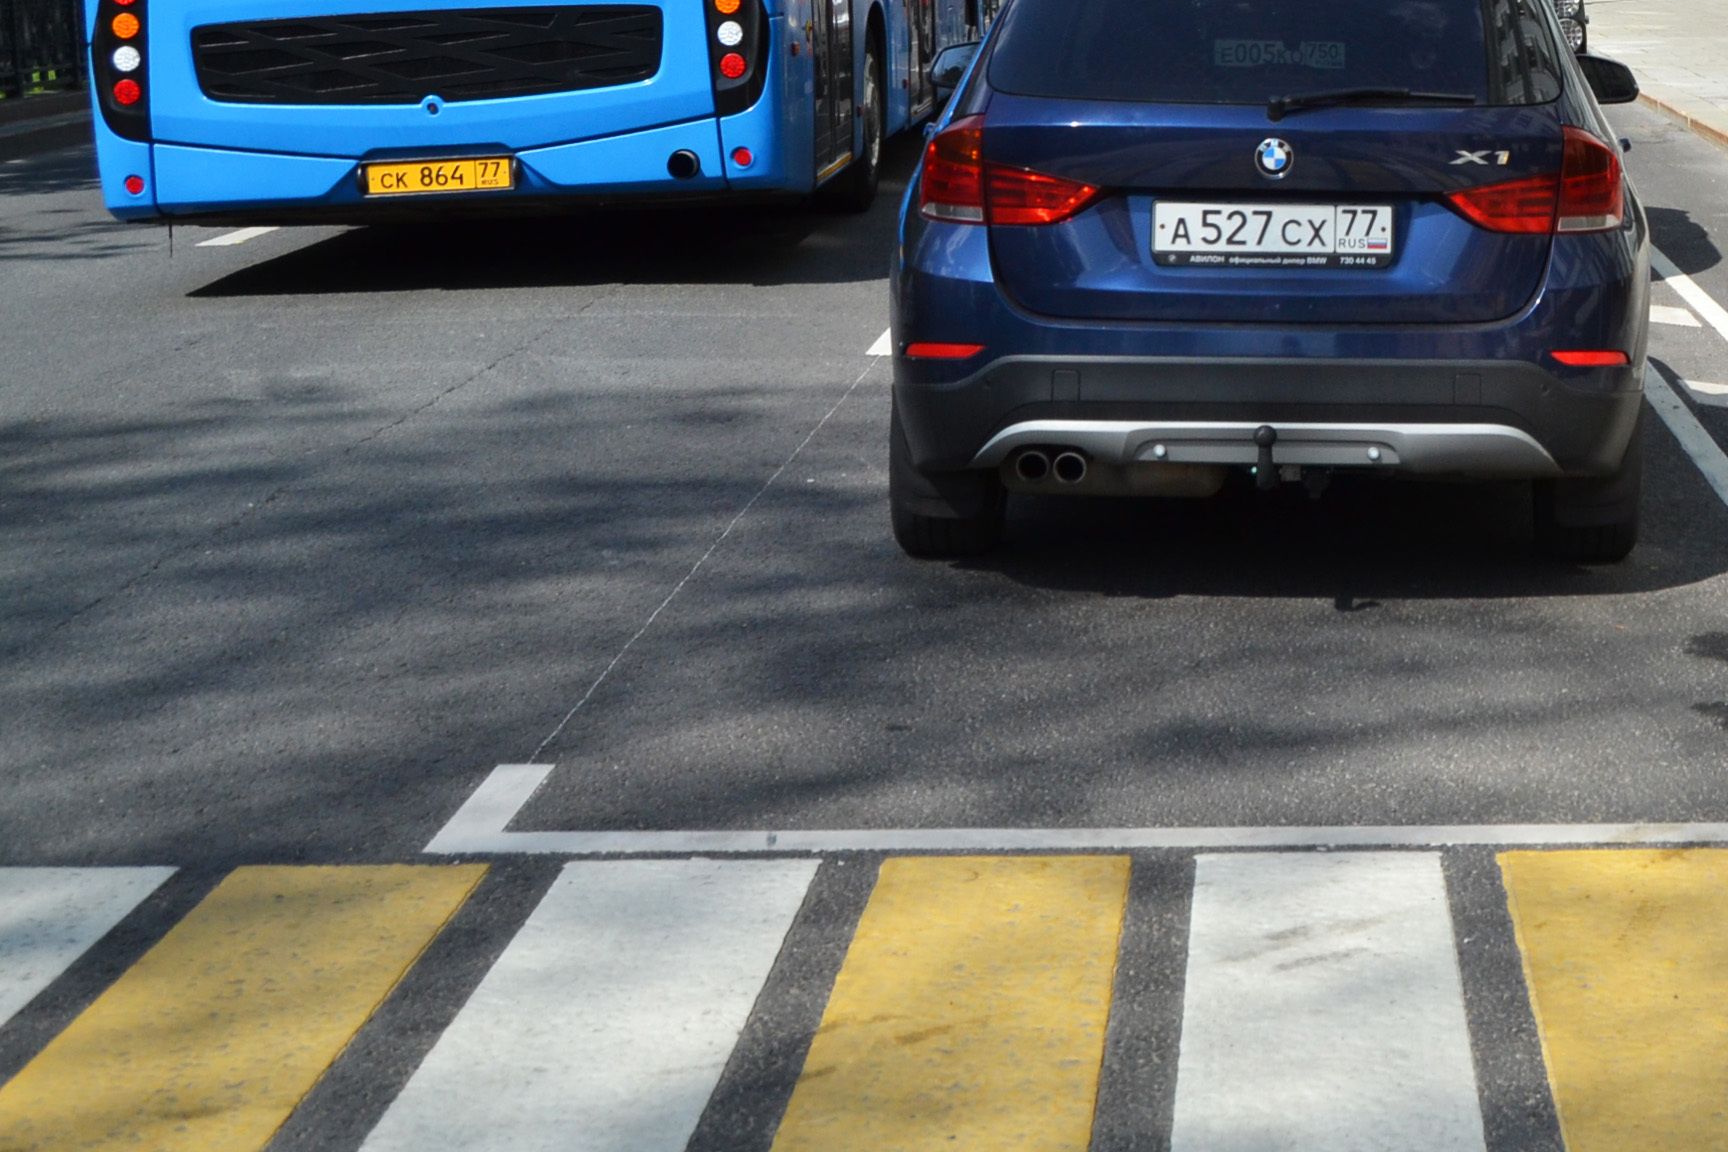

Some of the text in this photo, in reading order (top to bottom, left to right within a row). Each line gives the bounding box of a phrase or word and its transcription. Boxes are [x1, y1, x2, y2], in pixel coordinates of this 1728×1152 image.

[1448, 150, 1510, 165] X1
[420, 165, 464, 187] 864
[478, 162, 501, 178] 77
[481, 178, 499, 186] RUS
[1341, 209, 1378, 237] 77
[1338, 238, 1366, 248] RUS
[1189, 255, 1225, 263] АВИЛОН
[1229, 256, 1281, 265] официальный
[1306, 257, 1327, 265] BMW
[1340, 257, 1354, 265] 730
[1355, 257, 1366, 265] 44
